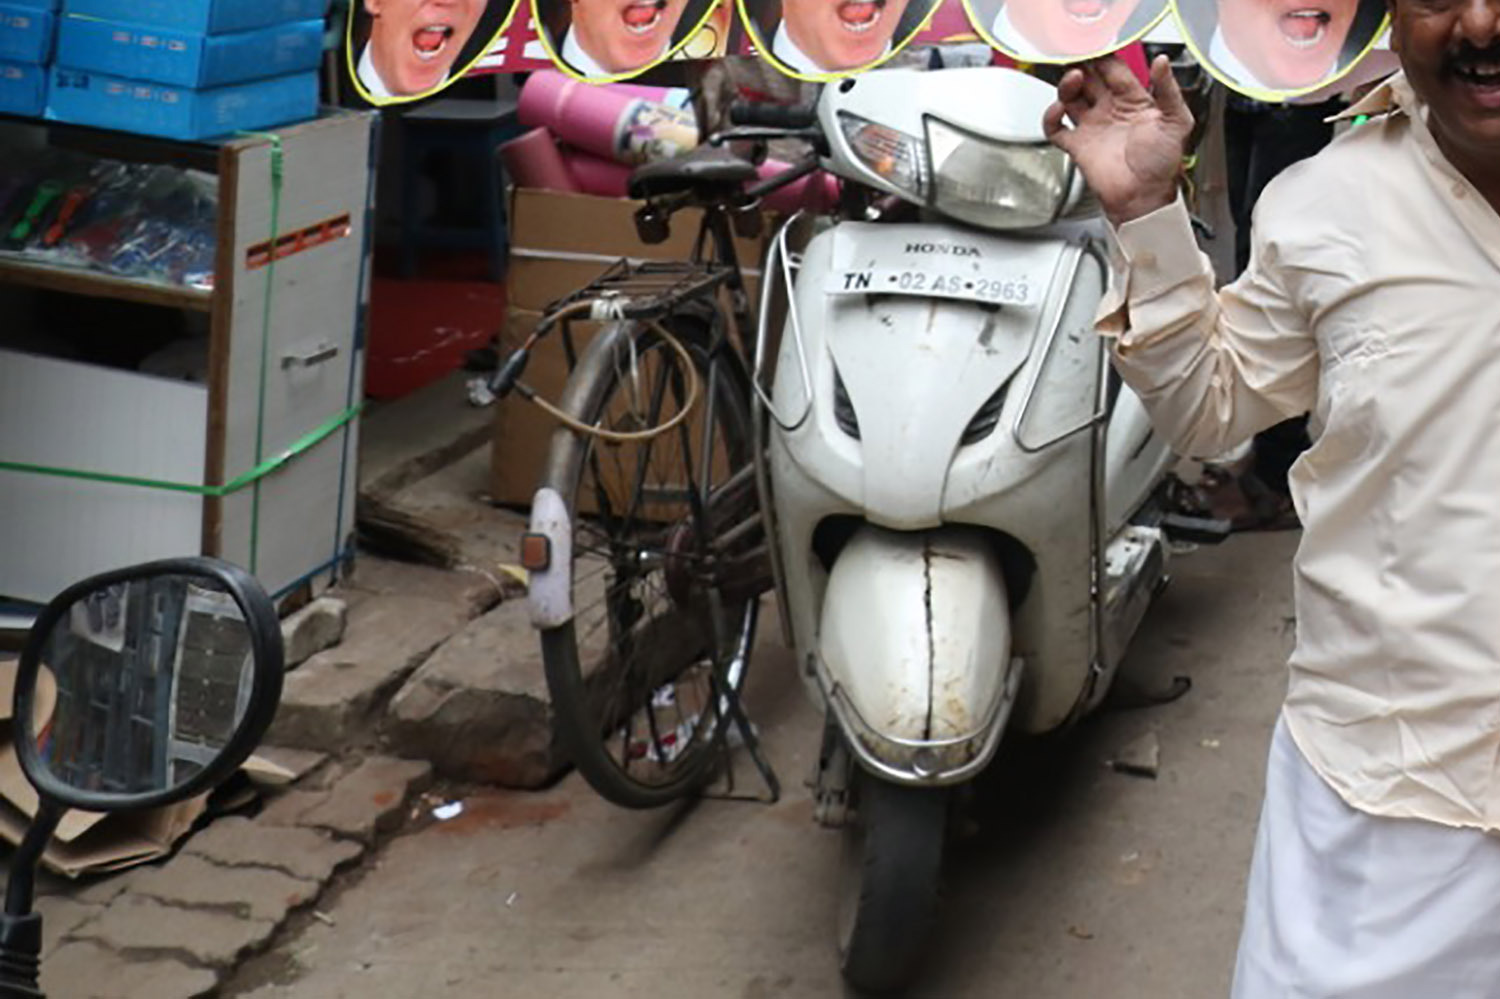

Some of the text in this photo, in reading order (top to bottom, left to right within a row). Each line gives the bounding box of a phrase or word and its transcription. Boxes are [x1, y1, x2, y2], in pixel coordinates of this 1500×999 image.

[904, 242, 983, 258] HONDA
[843, 272, 1030, 302] TN 02 AS 2963
